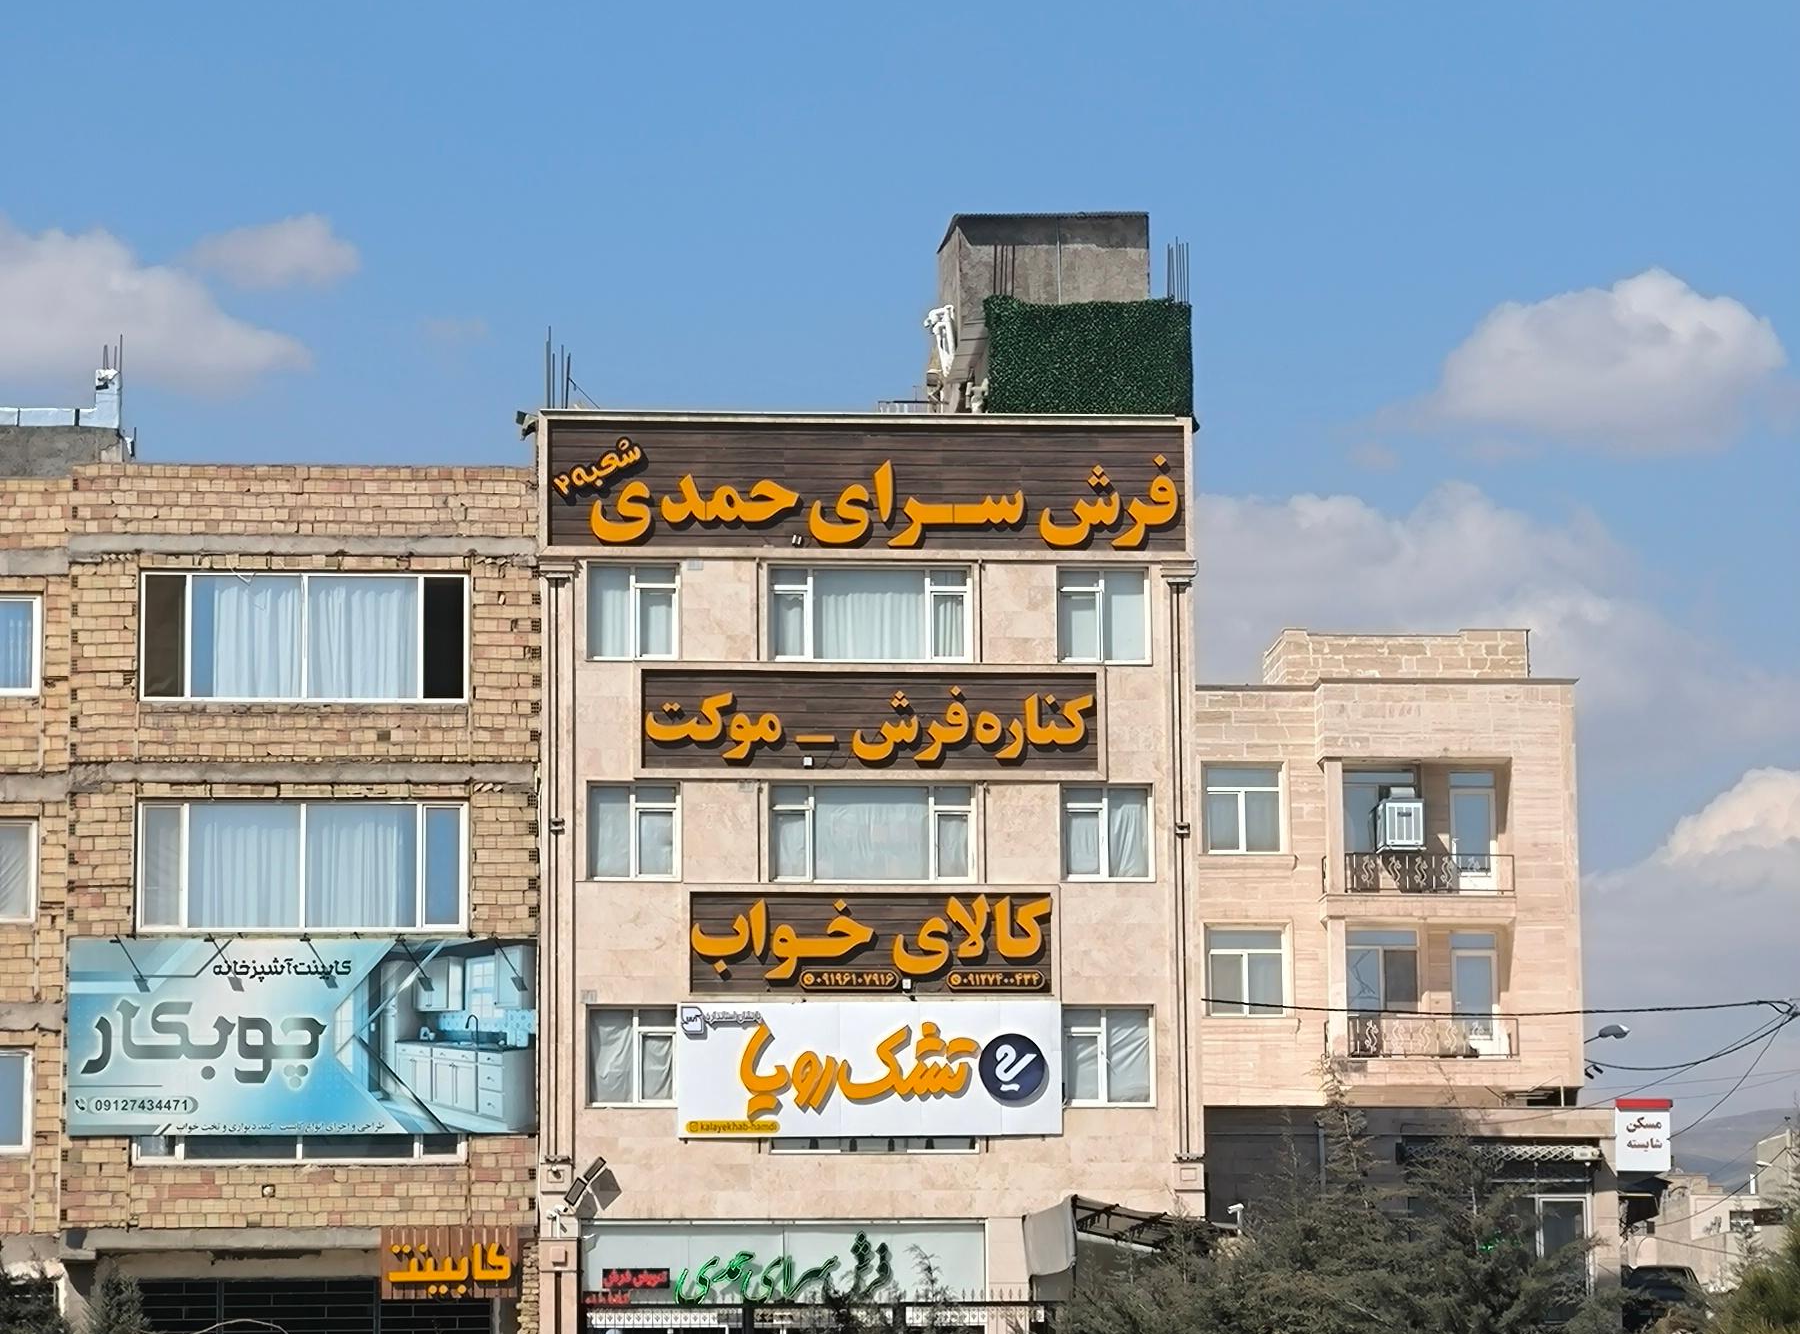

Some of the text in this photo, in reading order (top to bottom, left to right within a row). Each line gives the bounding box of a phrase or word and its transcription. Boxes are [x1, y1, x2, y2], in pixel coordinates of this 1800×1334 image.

[571, 438, 642, 487] شعبه
[590, 454, 1180, 548] فرش سرای حمدی
[645, 691, 782, 760] موکت
[851, 685, 968, 762] فرش
[691, 893, 1053, 980] کالای خواب
[212, 957, 352, 982] کابینت آشپزخانه
[80, 998, 328, 1090] چوبکار
[740, 1021, 981, 1121] تشک رویا
[94, 1099, 188, 1112] 09127434471
[1625, 1116, 1663, 1133] مسکن
[1625, 1137, 1663, 1152] شایسته
[384, 1241, 513, 1296] کابینت
